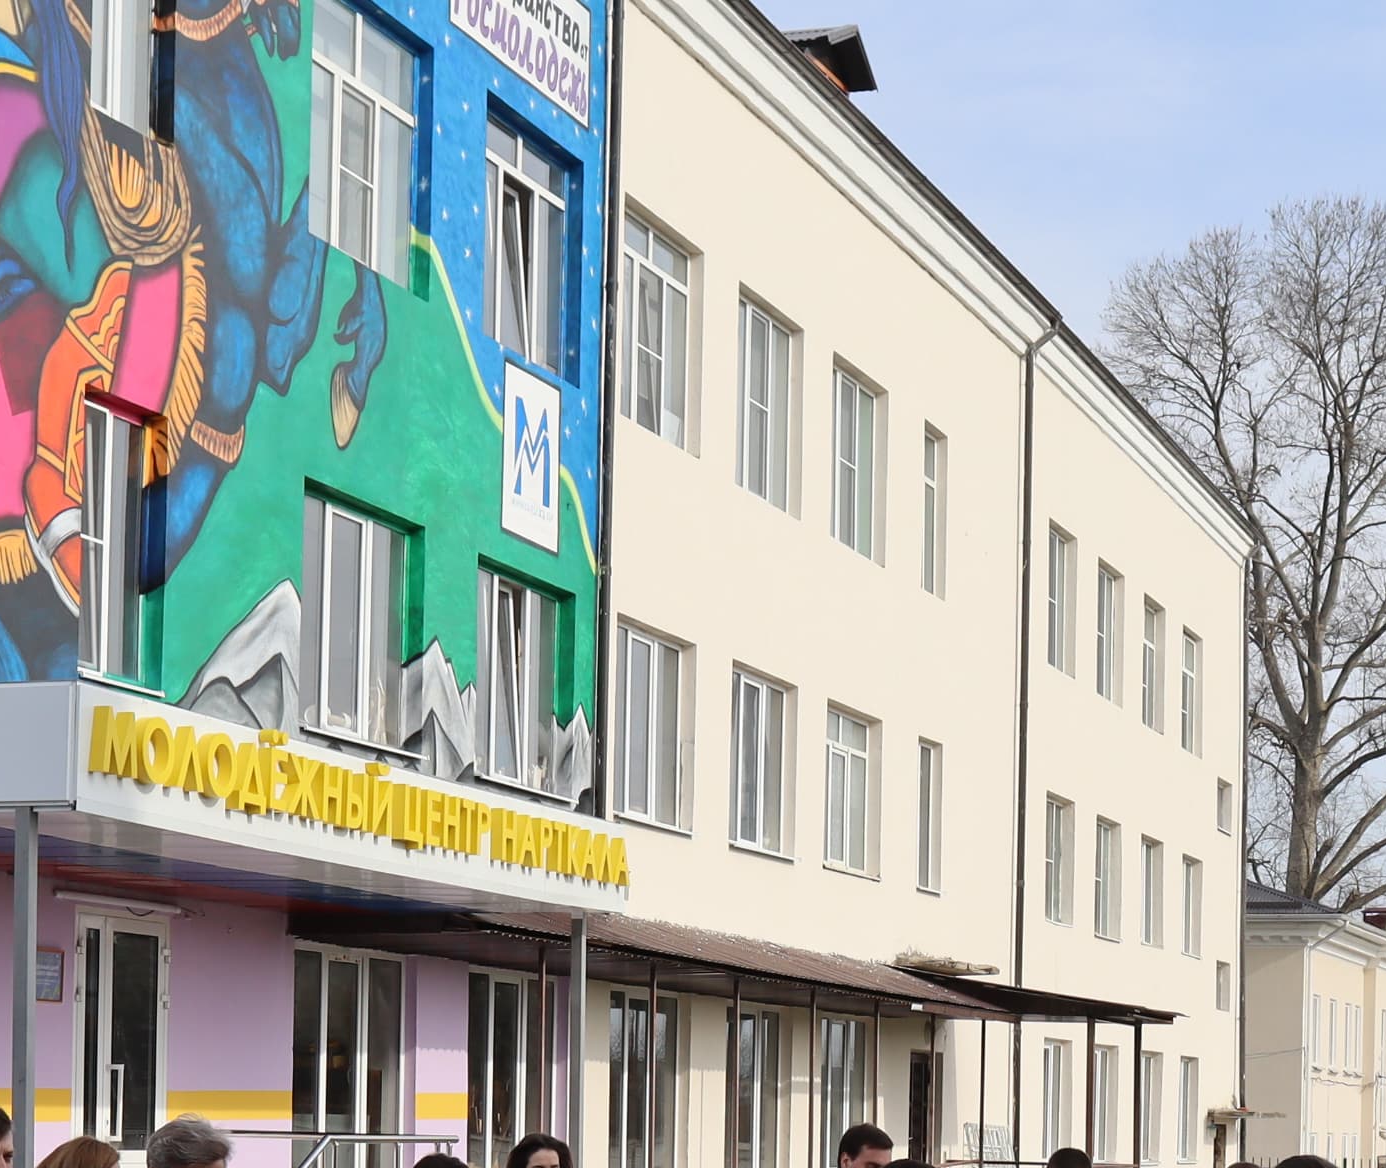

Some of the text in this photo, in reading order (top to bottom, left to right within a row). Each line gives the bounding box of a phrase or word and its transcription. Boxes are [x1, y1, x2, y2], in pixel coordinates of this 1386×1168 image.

[89, 705, 629, 886] МОЛОДЁЖНЫЙ ЦЕНТР НАРТКАЛА
